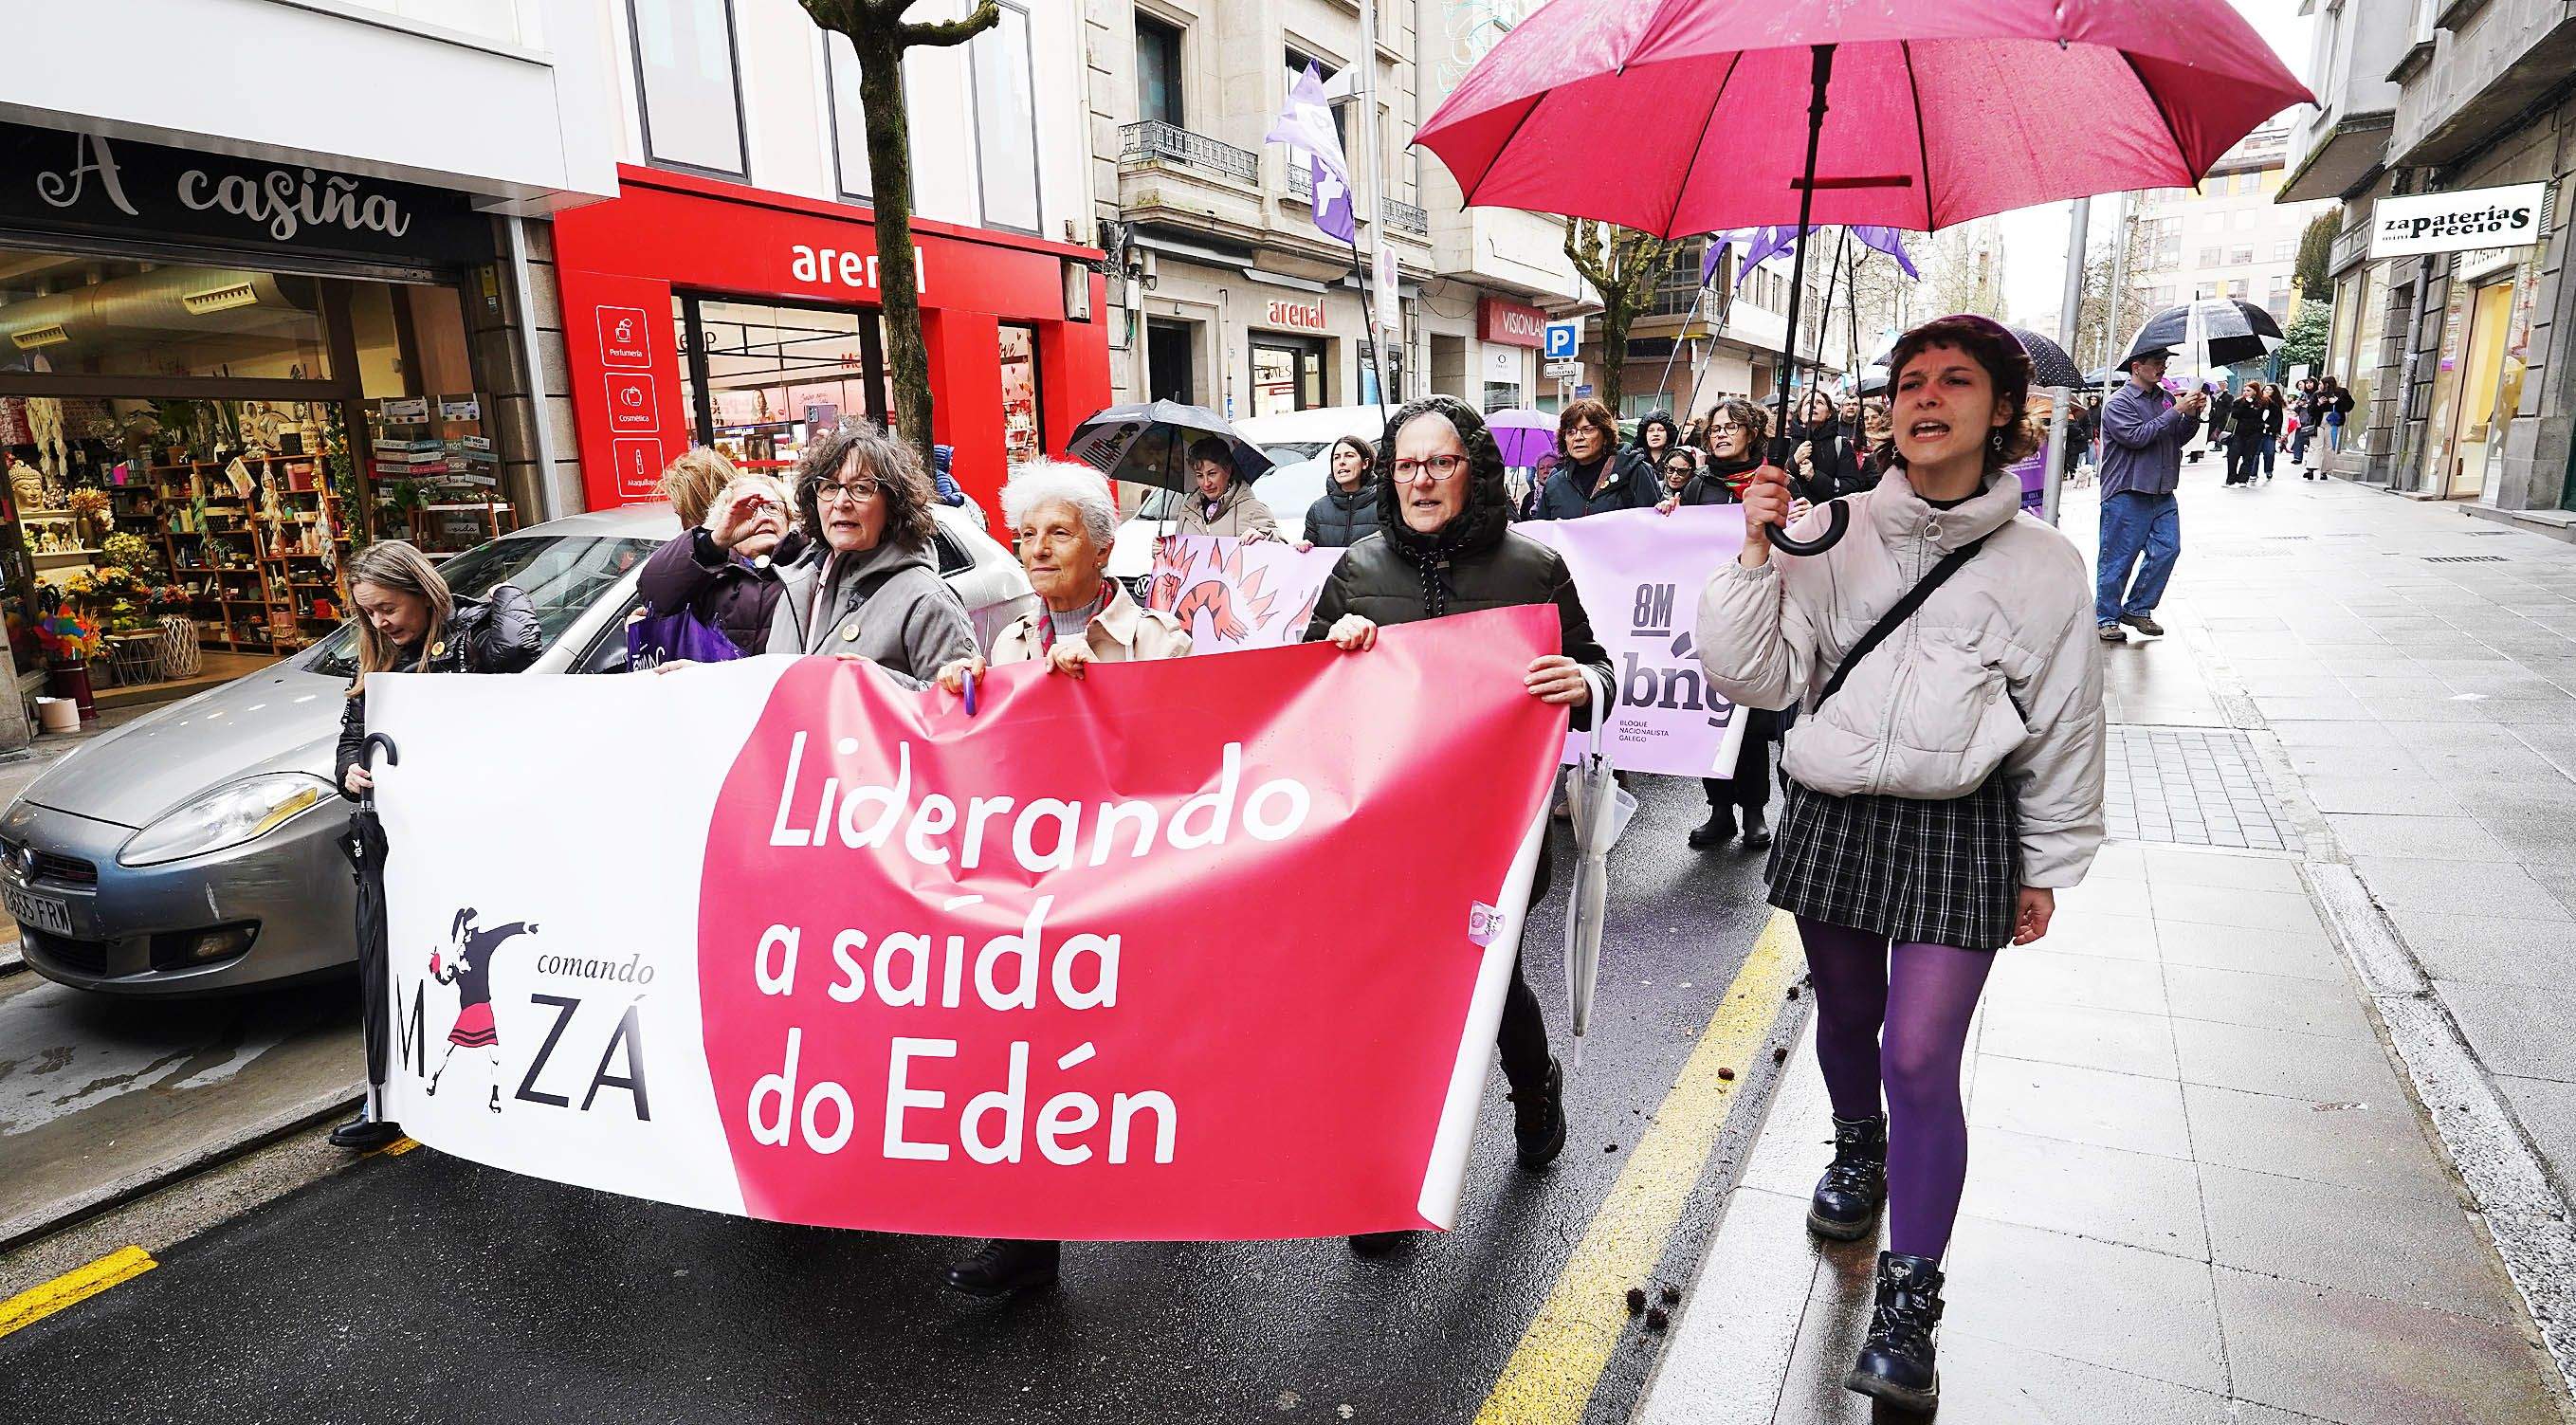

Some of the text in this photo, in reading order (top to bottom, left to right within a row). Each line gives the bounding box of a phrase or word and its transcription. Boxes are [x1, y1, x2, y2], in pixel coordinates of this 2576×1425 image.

[37, 134, 411, 241] A casiña
[791, 245, 926, 294] arel
[1270, 299, 1326, 329] arenal
[609, 348, 643, 357] Perfumería
[1551, 329, 1570, 354] P
[618, 414, 650, 423] Cosmética
[1633, 583, 1675, 628] 8M
[1619, 727, 1670, 736] NACIONALISTA
[769, 730, 1310, 873] Liderando
[537, 952, 655, 985] comando
[755, 894, 1122, 1012] a saída
[747, 1027, 1178, 1166] do Edén
